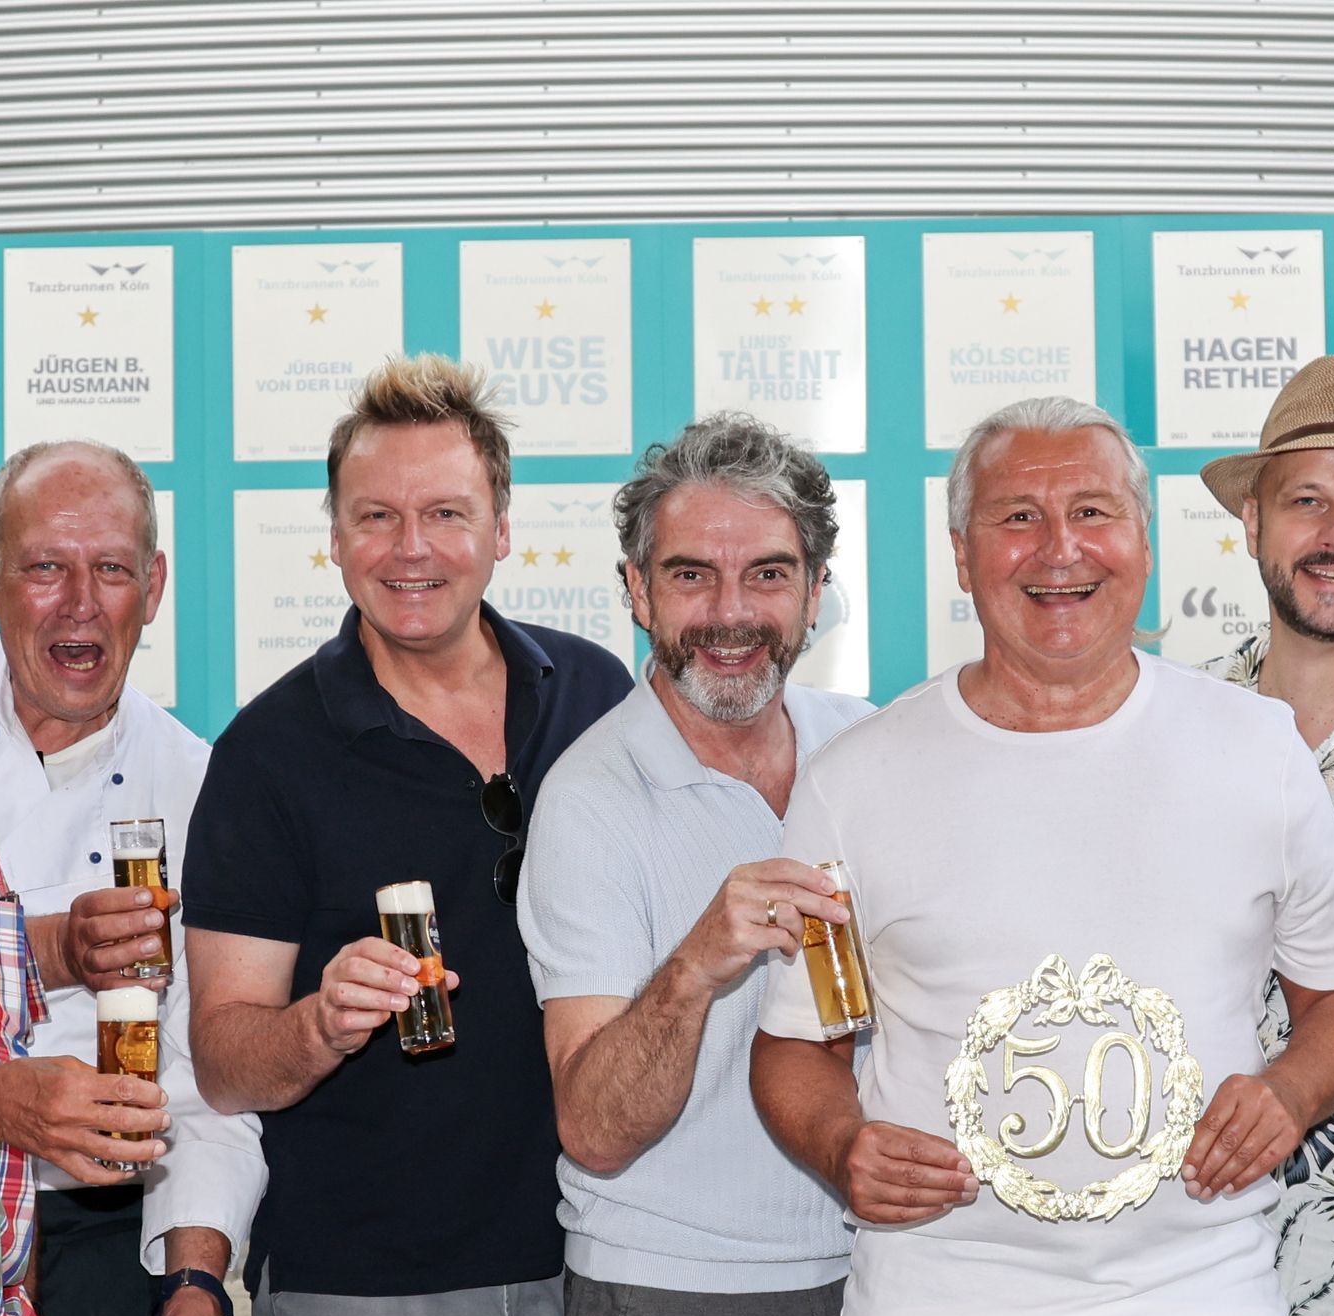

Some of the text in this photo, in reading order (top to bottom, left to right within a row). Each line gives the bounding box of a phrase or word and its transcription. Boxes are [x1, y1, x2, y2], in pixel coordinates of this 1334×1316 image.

[484, 271, 608, 285] Tanzbrunnen Köln
[718, 269, 841, 283] Tanzbrunnen Köln
[947, 265, 1070, 279] Tanzbrunnen Köln
[1177, 263, 1301, 277] Tanzbrunnen Köln
[27, 280, 150, 293] Tanzbrunnen Köln
[257, 277, 380, 290] Tanzbrunnen Köln
[486, 336, 605, 369] WISE
[949, 343, 1070, 366] KÖLSCHE
[1183, 337, 1297, 362] HAGEN
[33, 354, 144, 374] JÜRGEN B.
[283, 359, 352, 376] JÜRGEN
[719, 349, 841, 381] TALENT
[950, 368, 1071, 385] WEIHNACHT
[1183, 367, 1298, 389] RETHER
[27, 377, 150, 394] HAUSMANN
[256, 380, 291, 392] VON
[296, 379, 330, 392] DER
[486, 371, 608, 406] GUYS
[749, 380, 823, 401] PROBE
[274, 595, 351, 608] DR. ECKA
[487, 586, 610, 610] LUDWIG
[1222, 603, 1246, 617] lit.
[301, 616, 335, 628] VON
[998, 1031, 1153, 1159] 50
